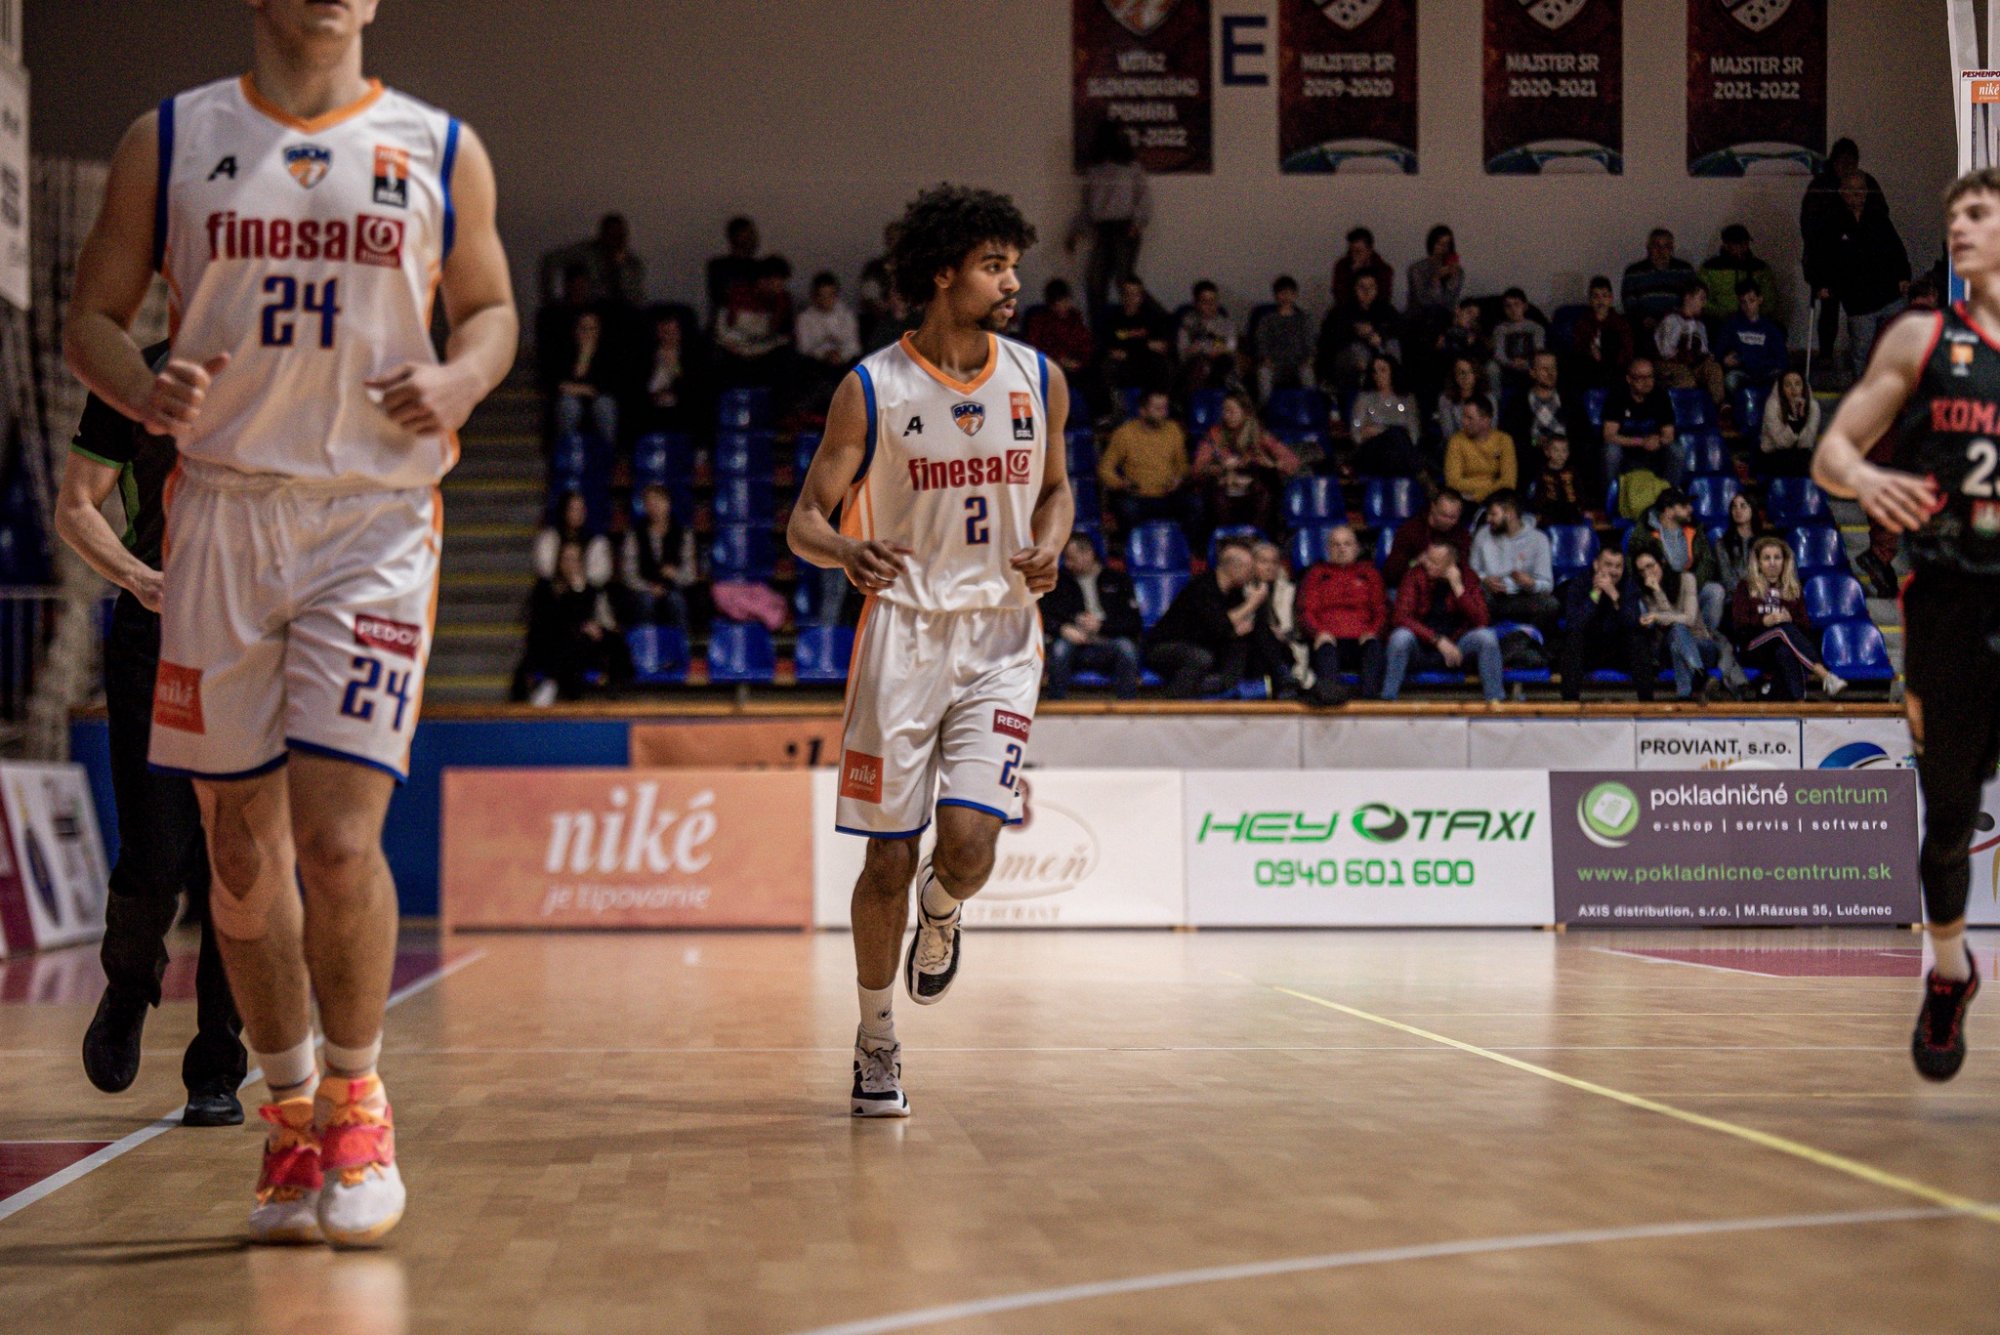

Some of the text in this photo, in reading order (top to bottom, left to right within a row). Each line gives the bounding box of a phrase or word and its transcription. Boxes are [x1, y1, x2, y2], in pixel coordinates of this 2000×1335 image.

[1221, 15, 1269, 86] E
[1301, 52, 1395, 73] MAJSTER SR
[1505, 53, 1600, 73] MAJSTER SR
[1709, 56, 1804, 76] MAJSTER SR
[1508, 79, 1599, 98] 2020-2021
[1713, 81, 1801, 100] 2021-2022
[206, 210, 348, 262] finesa
[260, 275, 341, 349] 24
[907, 456, 1003, 491] finesa
[964, 496, 990, 545] 2
[340, 654, 410, 733] 24
[1640, 739, 1792, 756] PROVIANT, s.r.o.
[849, 764, 877, 786] niké
[999, 743, 1022, 790] 2
[1650, 783, 1889, 810] pokladničné centrum
[545, 781, 717, 875] niké
[1197, 809, 1536, 844] HEY TAXI
[1652, 819, 1889, 832] e-shop servis software
[1255, 858, 1476, 887] 0940 601 600
[1577, 863, 1893, 884] www.pokladnicne-centrum.sk
[1578, 904, 1610, 918] AXIS
[1613, 904, 1695, 919] distribution,
[1698, 906, 1732, 918] s.r.o.
[1744, 903, 1808, 917] M.Rázusa
[1836, 902, 1893, 917] Lučenec
